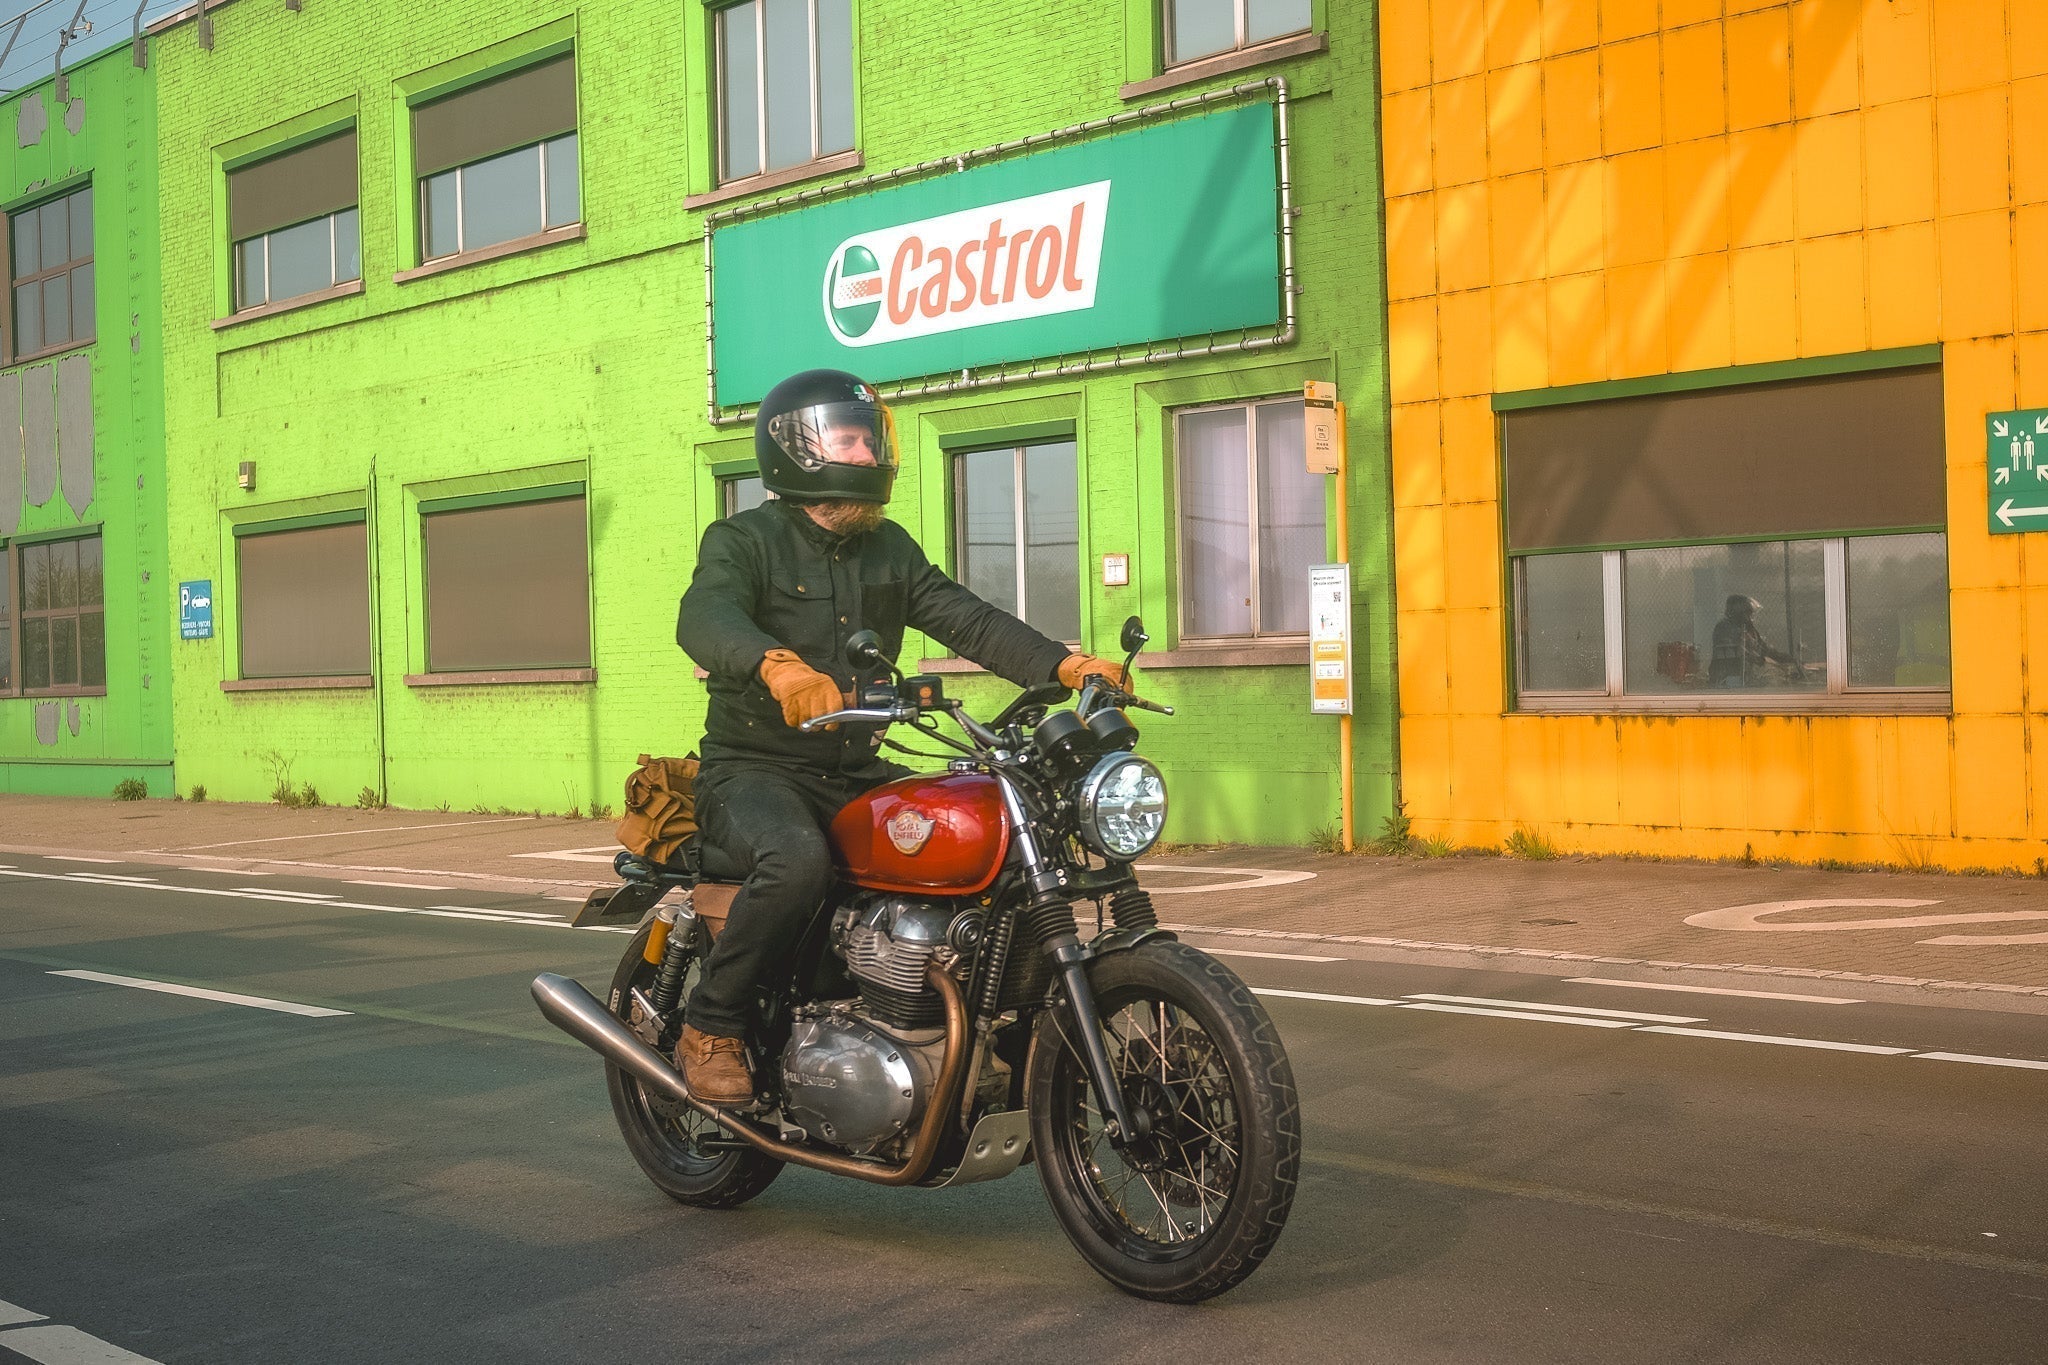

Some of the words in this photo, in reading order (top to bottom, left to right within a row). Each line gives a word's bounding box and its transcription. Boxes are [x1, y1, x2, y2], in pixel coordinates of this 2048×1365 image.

[887, 201, 1085, 325] Castrol
[181, 588, 190, 618] P
[894, 832, 924, 840] ENFIELD
[895, 821, 920, 831] ROYAL
